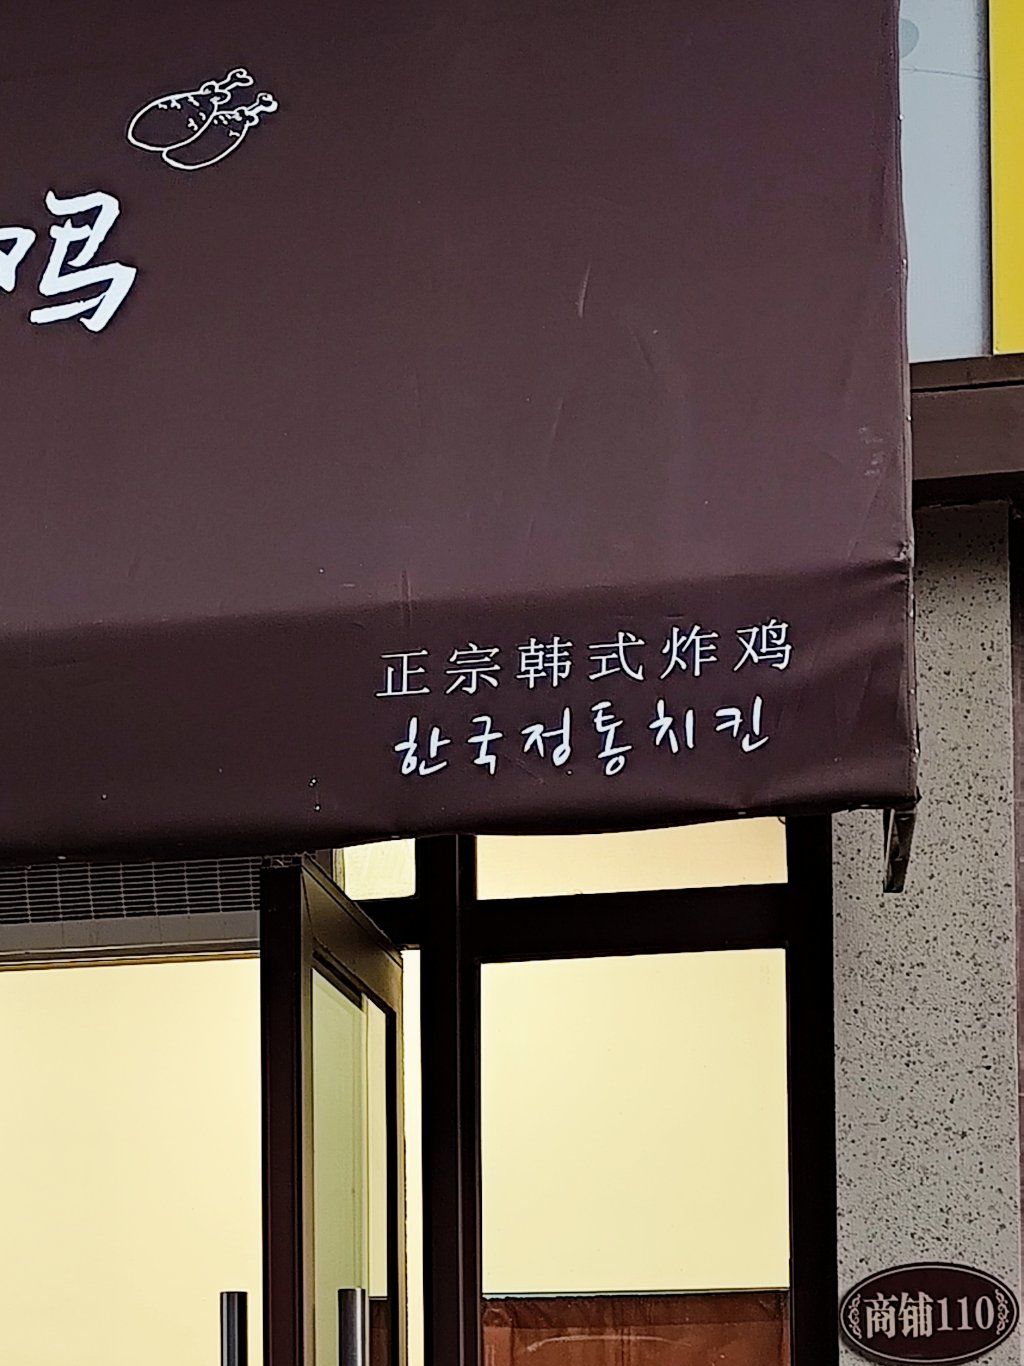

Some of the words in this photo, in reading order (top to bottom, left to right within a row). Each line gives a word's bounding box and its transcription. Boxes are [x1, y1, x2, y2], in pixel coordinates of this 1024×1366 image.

[376, 618, 792, 697] 正宗韩式炸鸡
[863, 1291, 995, 1339] 商铺110
